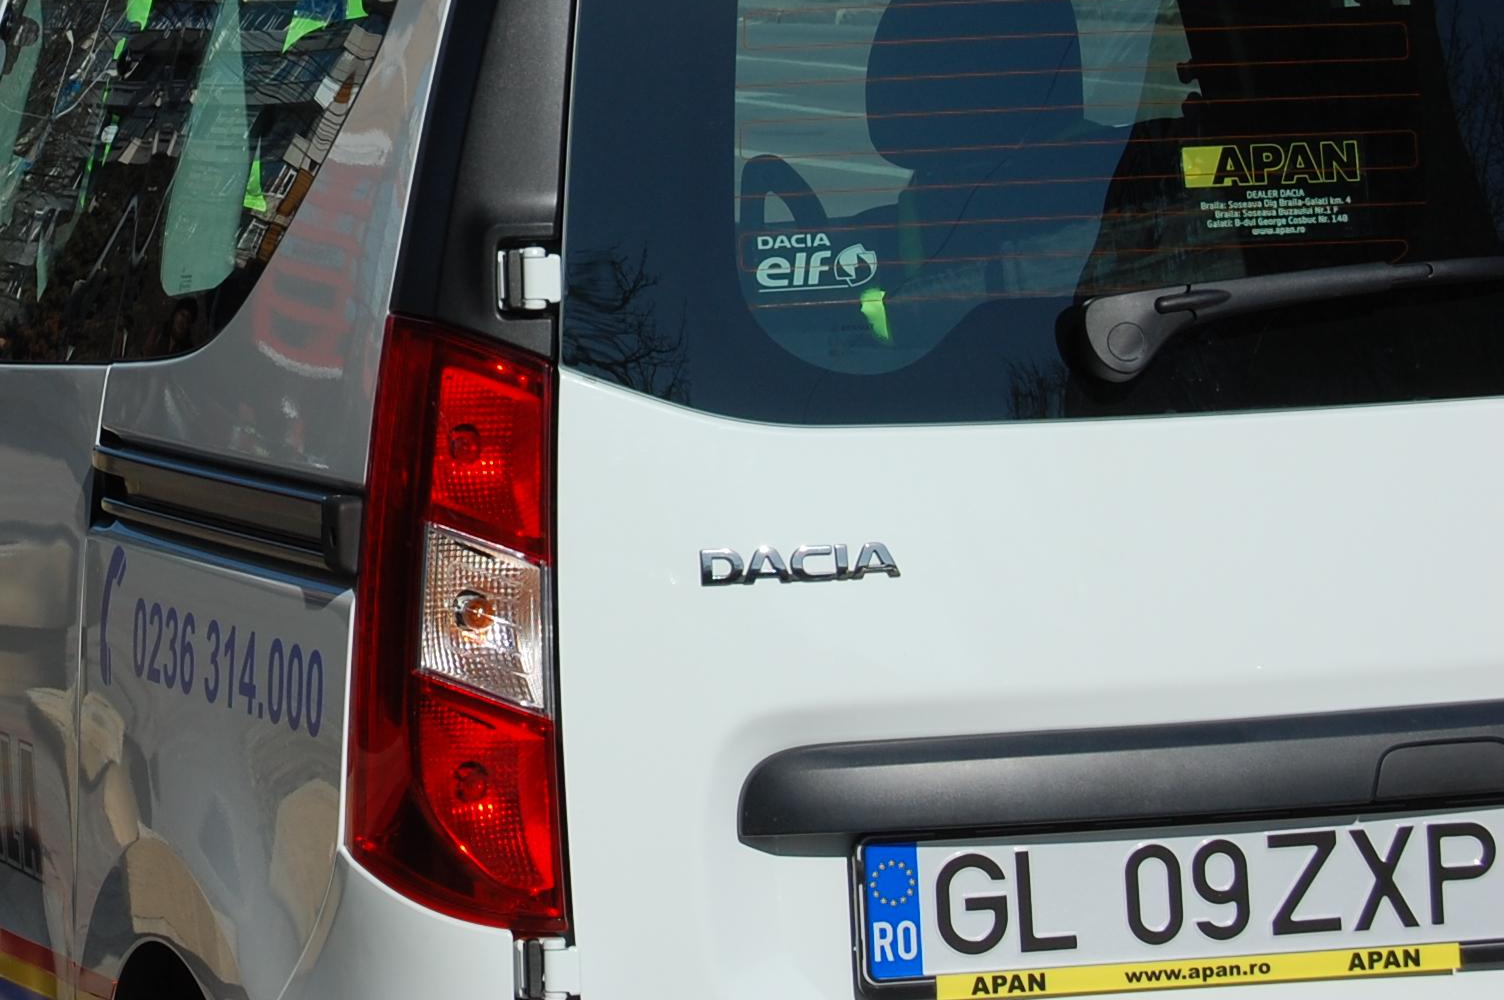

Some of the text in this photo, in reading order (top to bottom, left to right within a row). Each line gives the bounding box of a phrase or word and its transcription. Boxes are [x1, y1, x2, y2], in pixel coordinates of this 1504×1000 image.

[1212, 140, 1361, 186] APAN
[1246, 188, 1305, 199] DEALER DACIA
[1345, 195, 1351, 204] 4
[757, 233, 830, 249] DACIA
[1252, 226, 1306, 236] www.apan.ro
[756, 250, 831, 287] elf
[699, 541, 901, 587] DACIA
[133, 598, 324, 738] 0236 314.000
[935, 851, 1078, 956] GL
[873, 919, 918, 963] RO
[971, 948, 1421, 996] APAN www.apan.ro APAN
